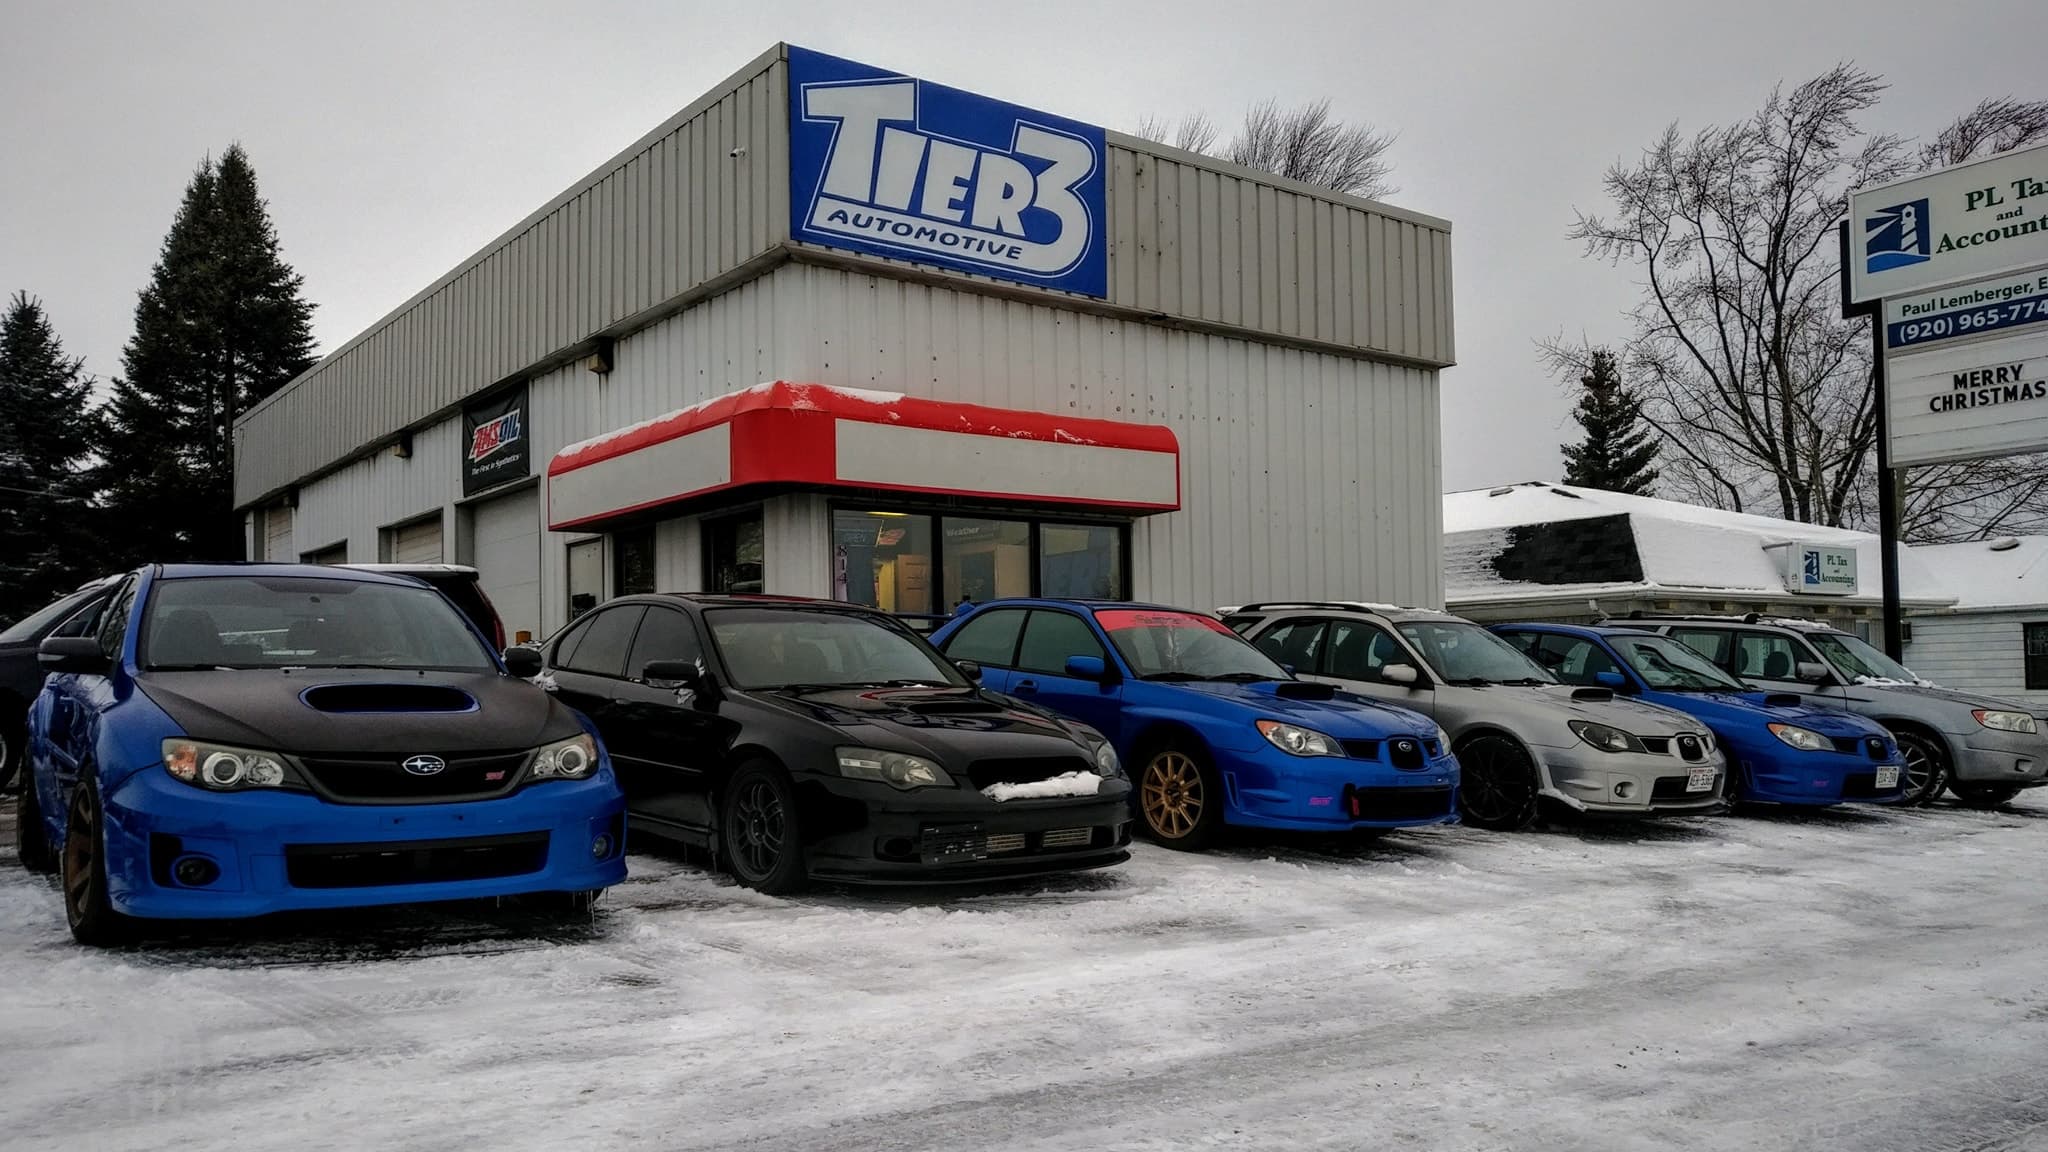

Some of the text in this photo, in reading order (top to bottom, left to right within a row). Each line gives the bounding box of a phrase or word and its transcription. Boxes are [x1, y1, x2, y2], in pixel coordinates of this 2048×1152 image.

[1964, 186, 2004, 212] PL
[1996, 206, 2024, 222] and
[827, 208, 1023, 260] AUTOMOTIVE
[1902, 299, 1936, 317] Paul
[1940, 281, 2034, 309] Lemberger,
[1900, 317, 1953, 343] (920)
[1953, 363, 2025, 391] MERRY
[1929, 380, 2046, 414] CHRISTMAS
[470, 411, 520, 460] AMSOIL
[1826, 554, 1848, 566] PL Tax
[1821, 573, 1855, 585] Accounting
